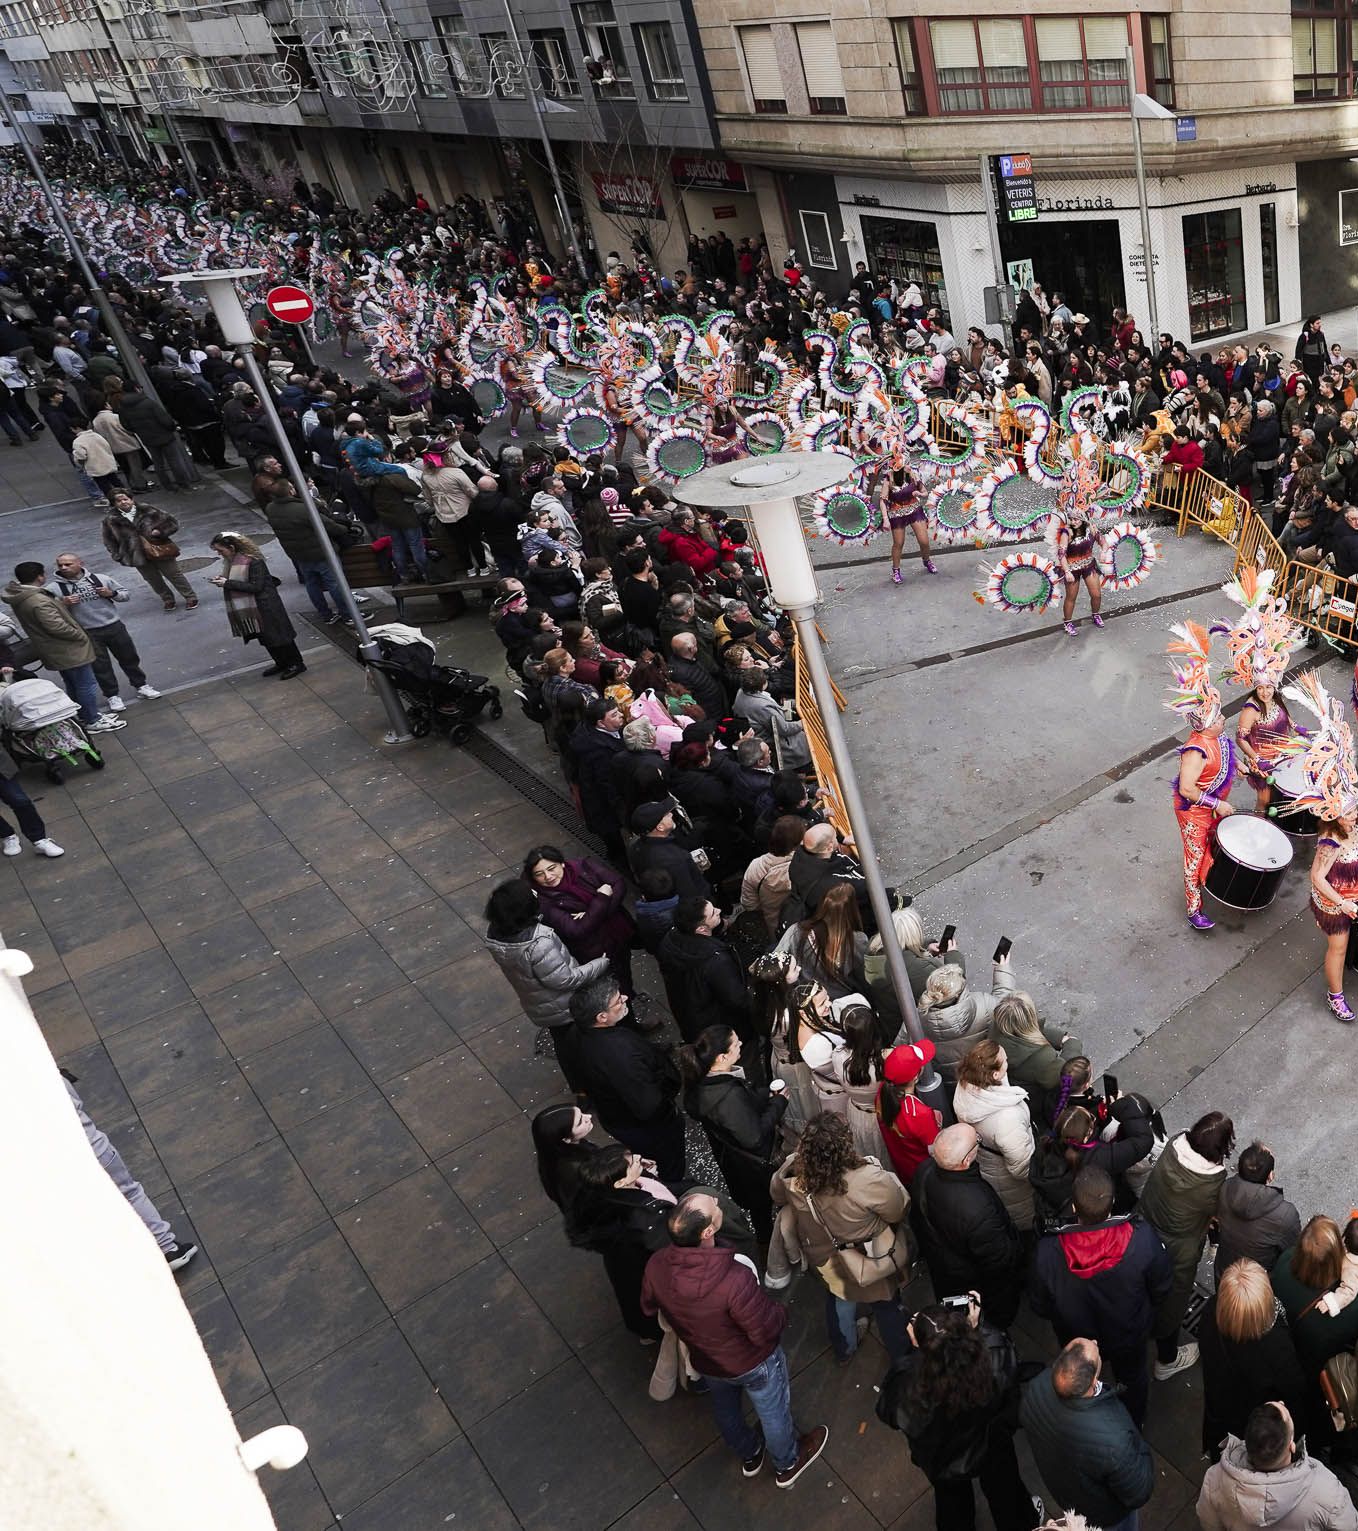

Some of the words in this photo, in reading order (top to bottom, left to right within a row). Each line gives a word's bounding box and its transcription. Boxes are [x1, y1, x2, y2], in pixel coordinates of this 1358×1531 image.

[1006, 187, 1033, 200] VETERIS
[1010, 199, 1033, 208] CENTRO
[1037, 196, 1114, 210] Florinda
[1008, 207, 1037, 221] LIBRE
